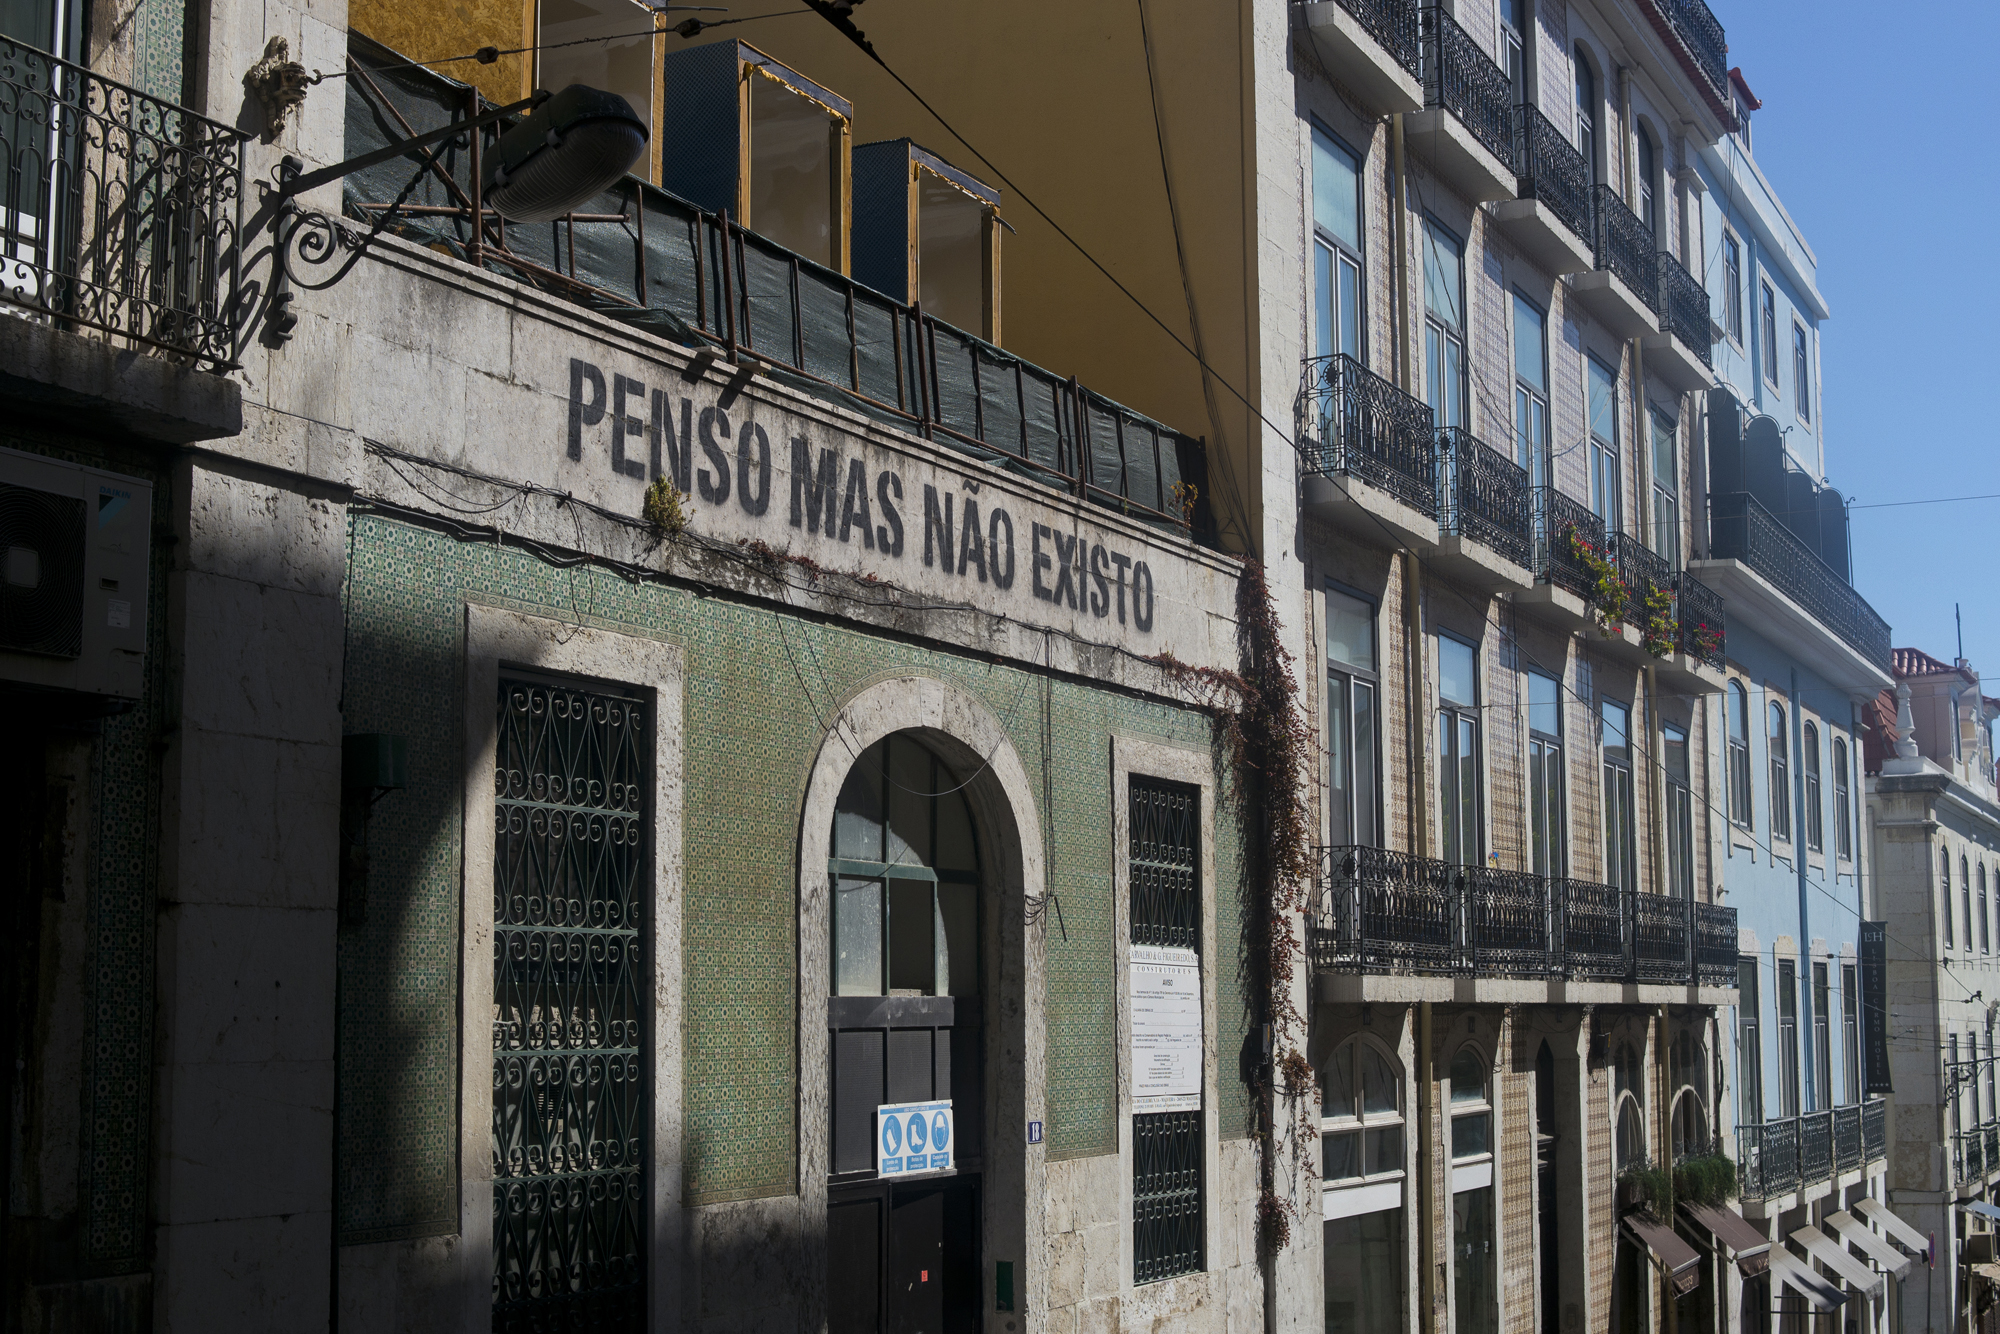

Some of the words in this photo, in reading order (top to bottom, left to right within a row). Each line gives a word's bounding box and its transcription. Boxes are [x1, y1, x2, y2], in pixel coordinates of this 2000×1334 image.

[99, 485, 132, 499] DAIKIN
[566, 357, 772, 517] PENSO
[790, 437, 904, 558] MAS
[924, 478, 1015, 591] NÃO
[1032, 520, 1154, 633] EXISTO
[1130, 950, 1153, 960] ARVALHO
[1032, 1123, 1040, 1141] 18
